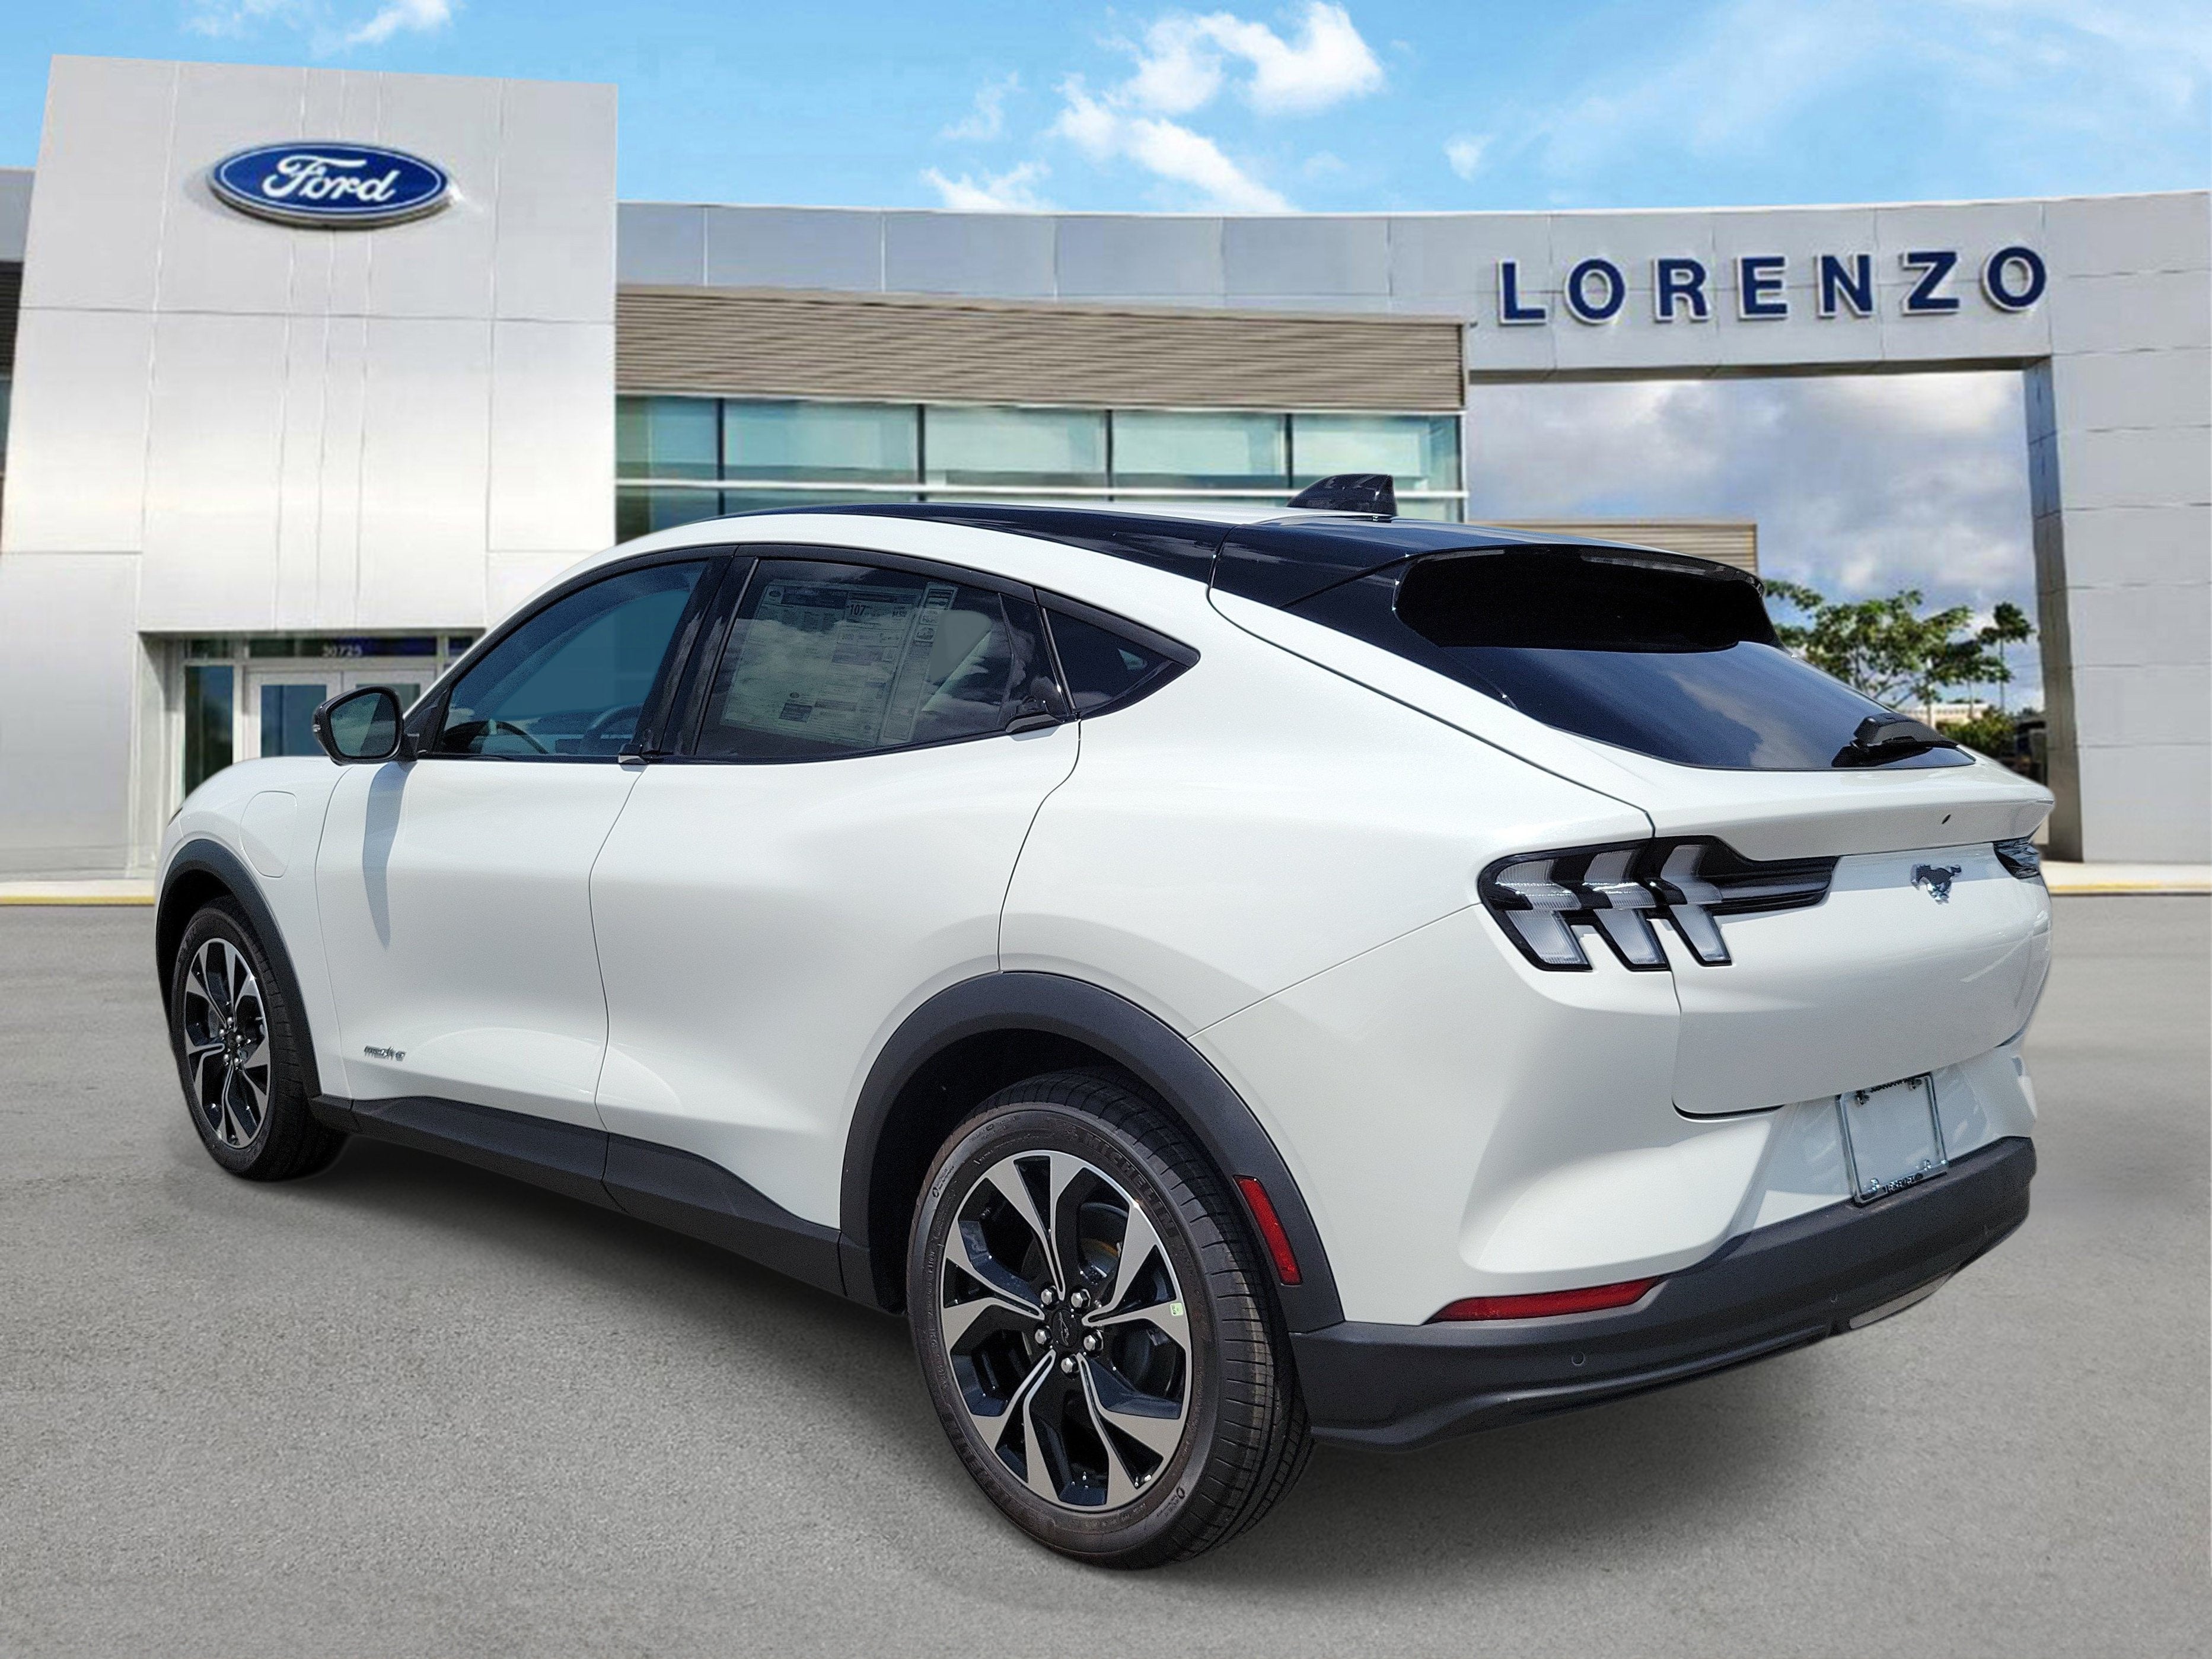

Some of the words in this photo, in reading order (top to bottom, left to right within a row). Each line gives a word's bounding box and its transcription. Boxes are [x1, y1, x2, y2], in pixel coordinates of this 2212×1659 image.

[262, 154, 400, 202] Ford
[1498, 246, 2048, 324] LORENZO
[850, 604, 866, 616] 107
